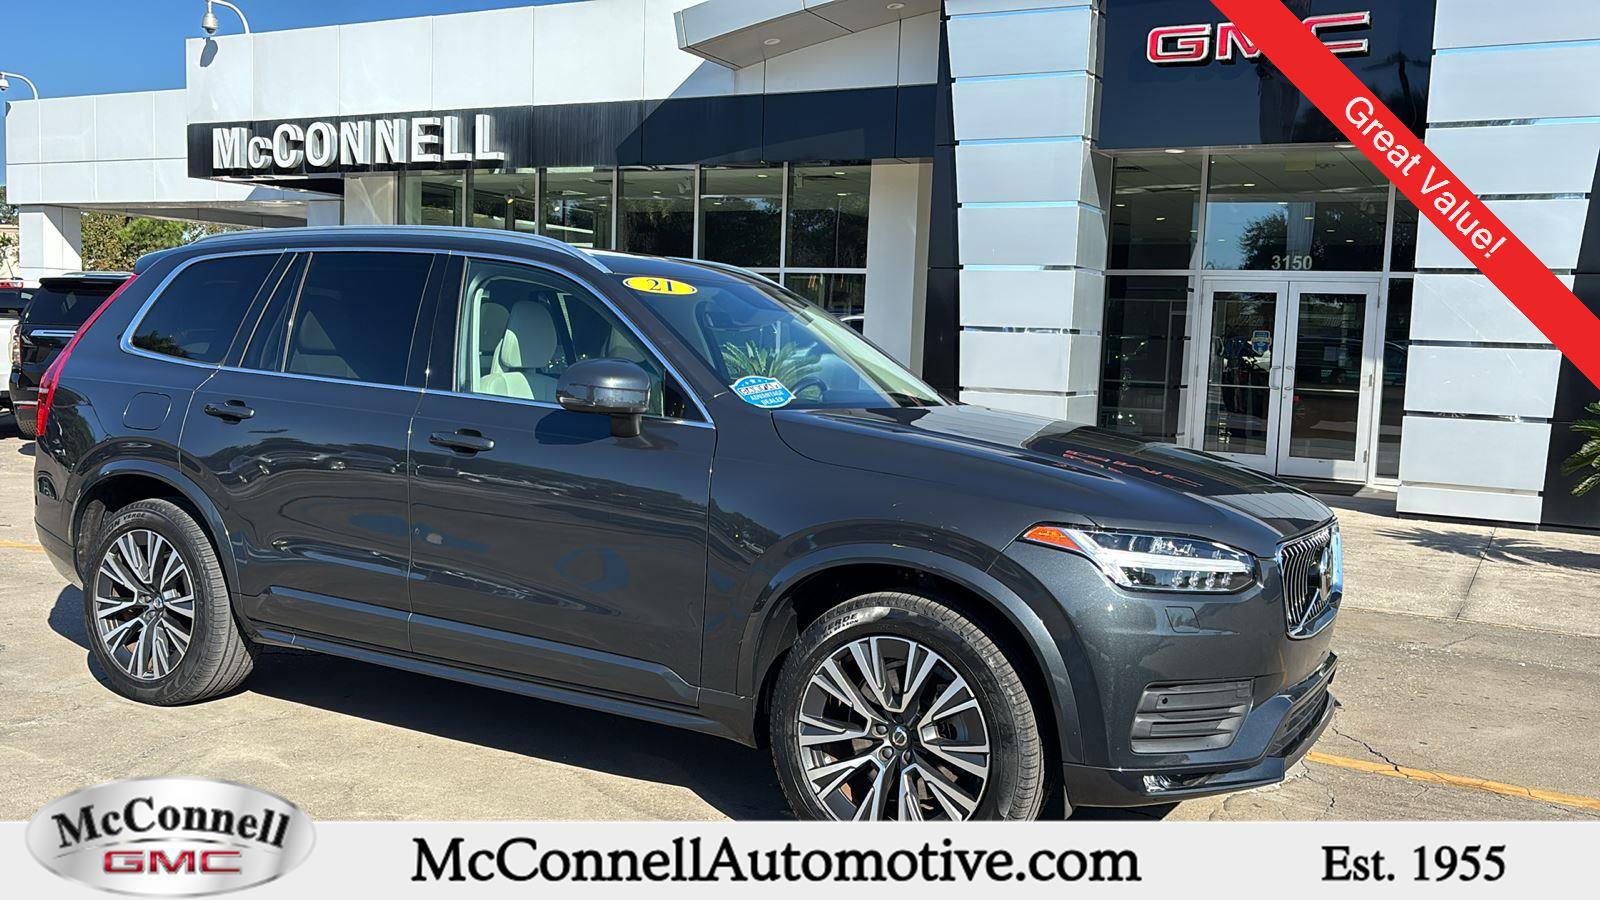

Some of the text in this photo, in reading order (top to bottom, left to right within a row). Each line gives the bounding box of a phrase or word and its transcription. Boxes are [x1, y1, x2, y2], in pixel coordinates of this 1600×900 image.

[212, 114, 505, 169] McCONNELL
[1271, 255, 1313, 271] 3150
[647, 278, 673, 292] 21
